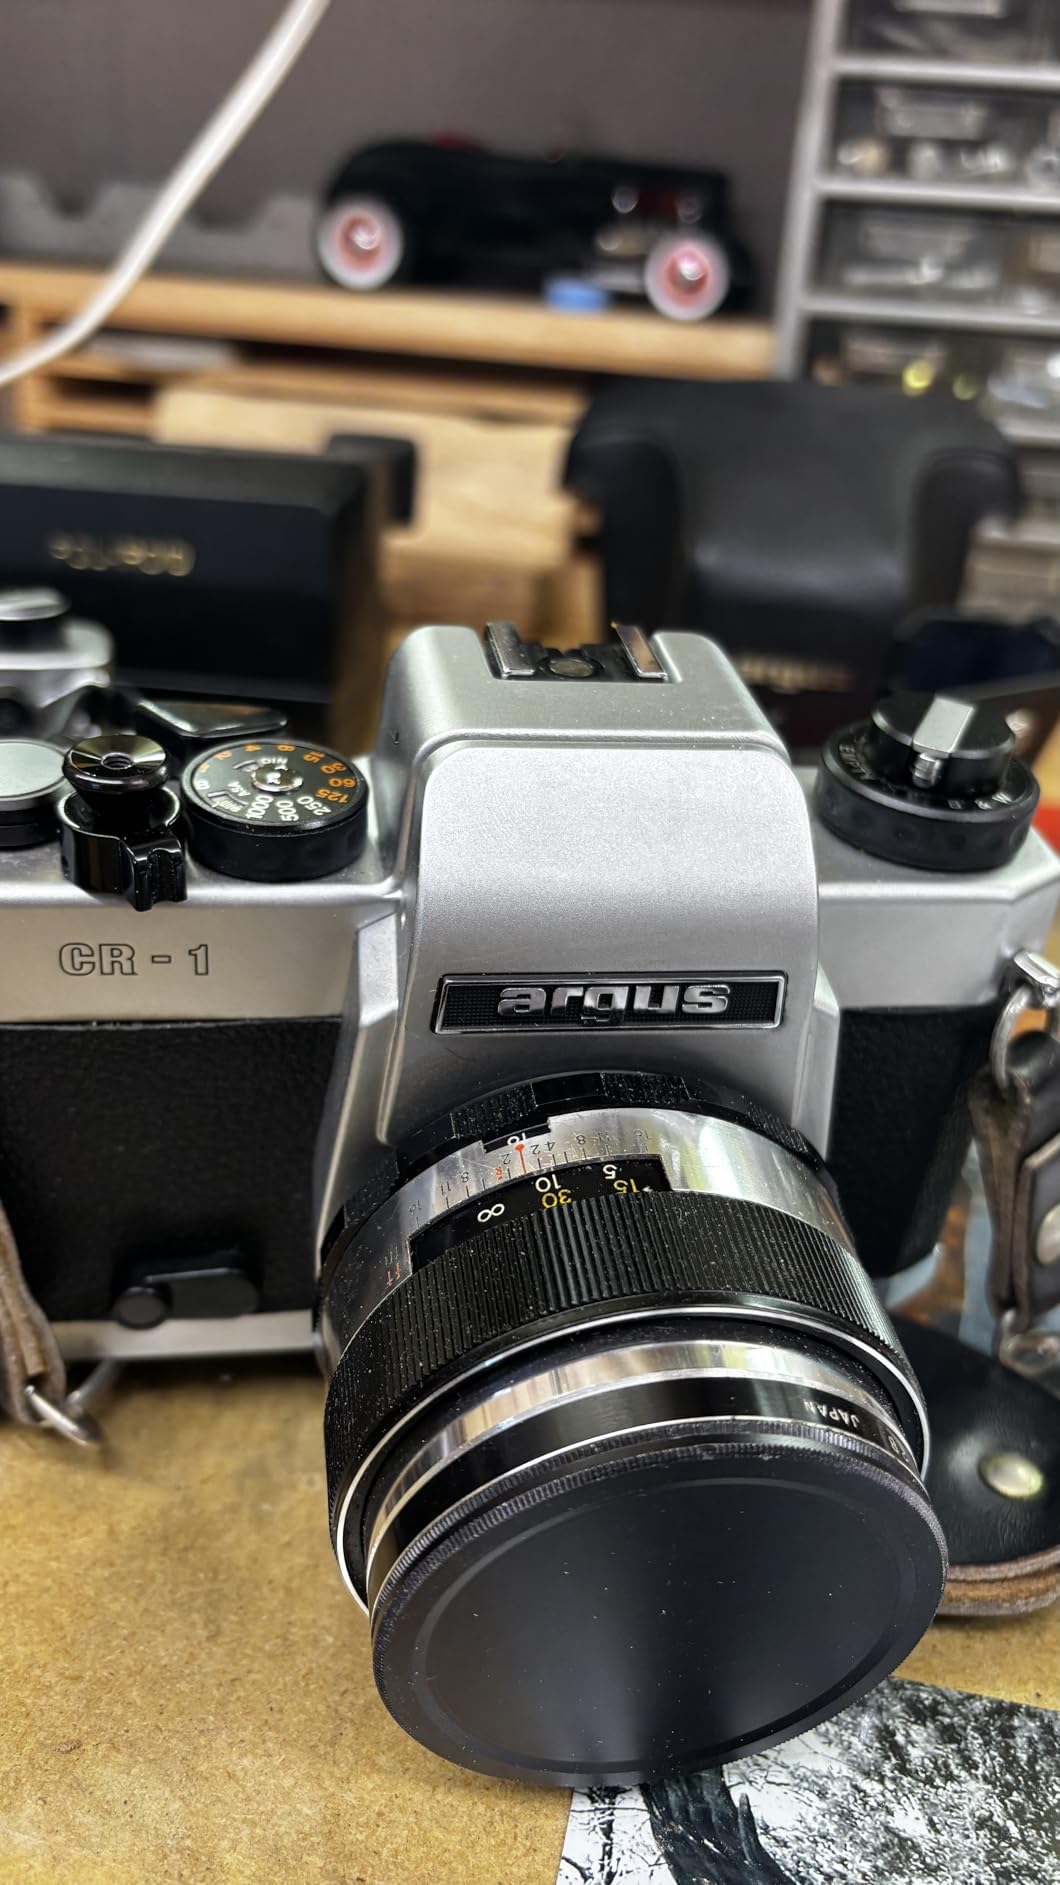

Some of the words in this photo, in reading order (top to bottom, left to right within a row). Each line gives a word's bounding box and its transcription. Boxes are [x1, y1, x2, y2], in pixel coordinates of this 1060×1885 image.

[277, 744, 296, 752] 8
[303, 751, 325, 763] 15
[320, 762, 347, 774] 30
[228, 781, 251, 797] ASA
[329, 777, 355, 788] 60
[297, 796, 332, 816] 250
[315, 788, 349, 804] 125
[244, 795, 274, 820] 1000
[276, 800, 300, 822] 500
[497, 985, 731, 1024] argus
[501, 1153, 512, 1165] 2
[531, 1144, 541, 1155] 2
[545, 1141, 556, 1152] 4
[576, 1134, 586, 1145] 8
[535, 1174, 562, 1192] 10
[602, 1164, 617, 1180] 5
[542, 1189, 572, 1208] 30
[613, 1178, 640, 1194] 15
[803, 1400, 859, 1428] JAPAN
